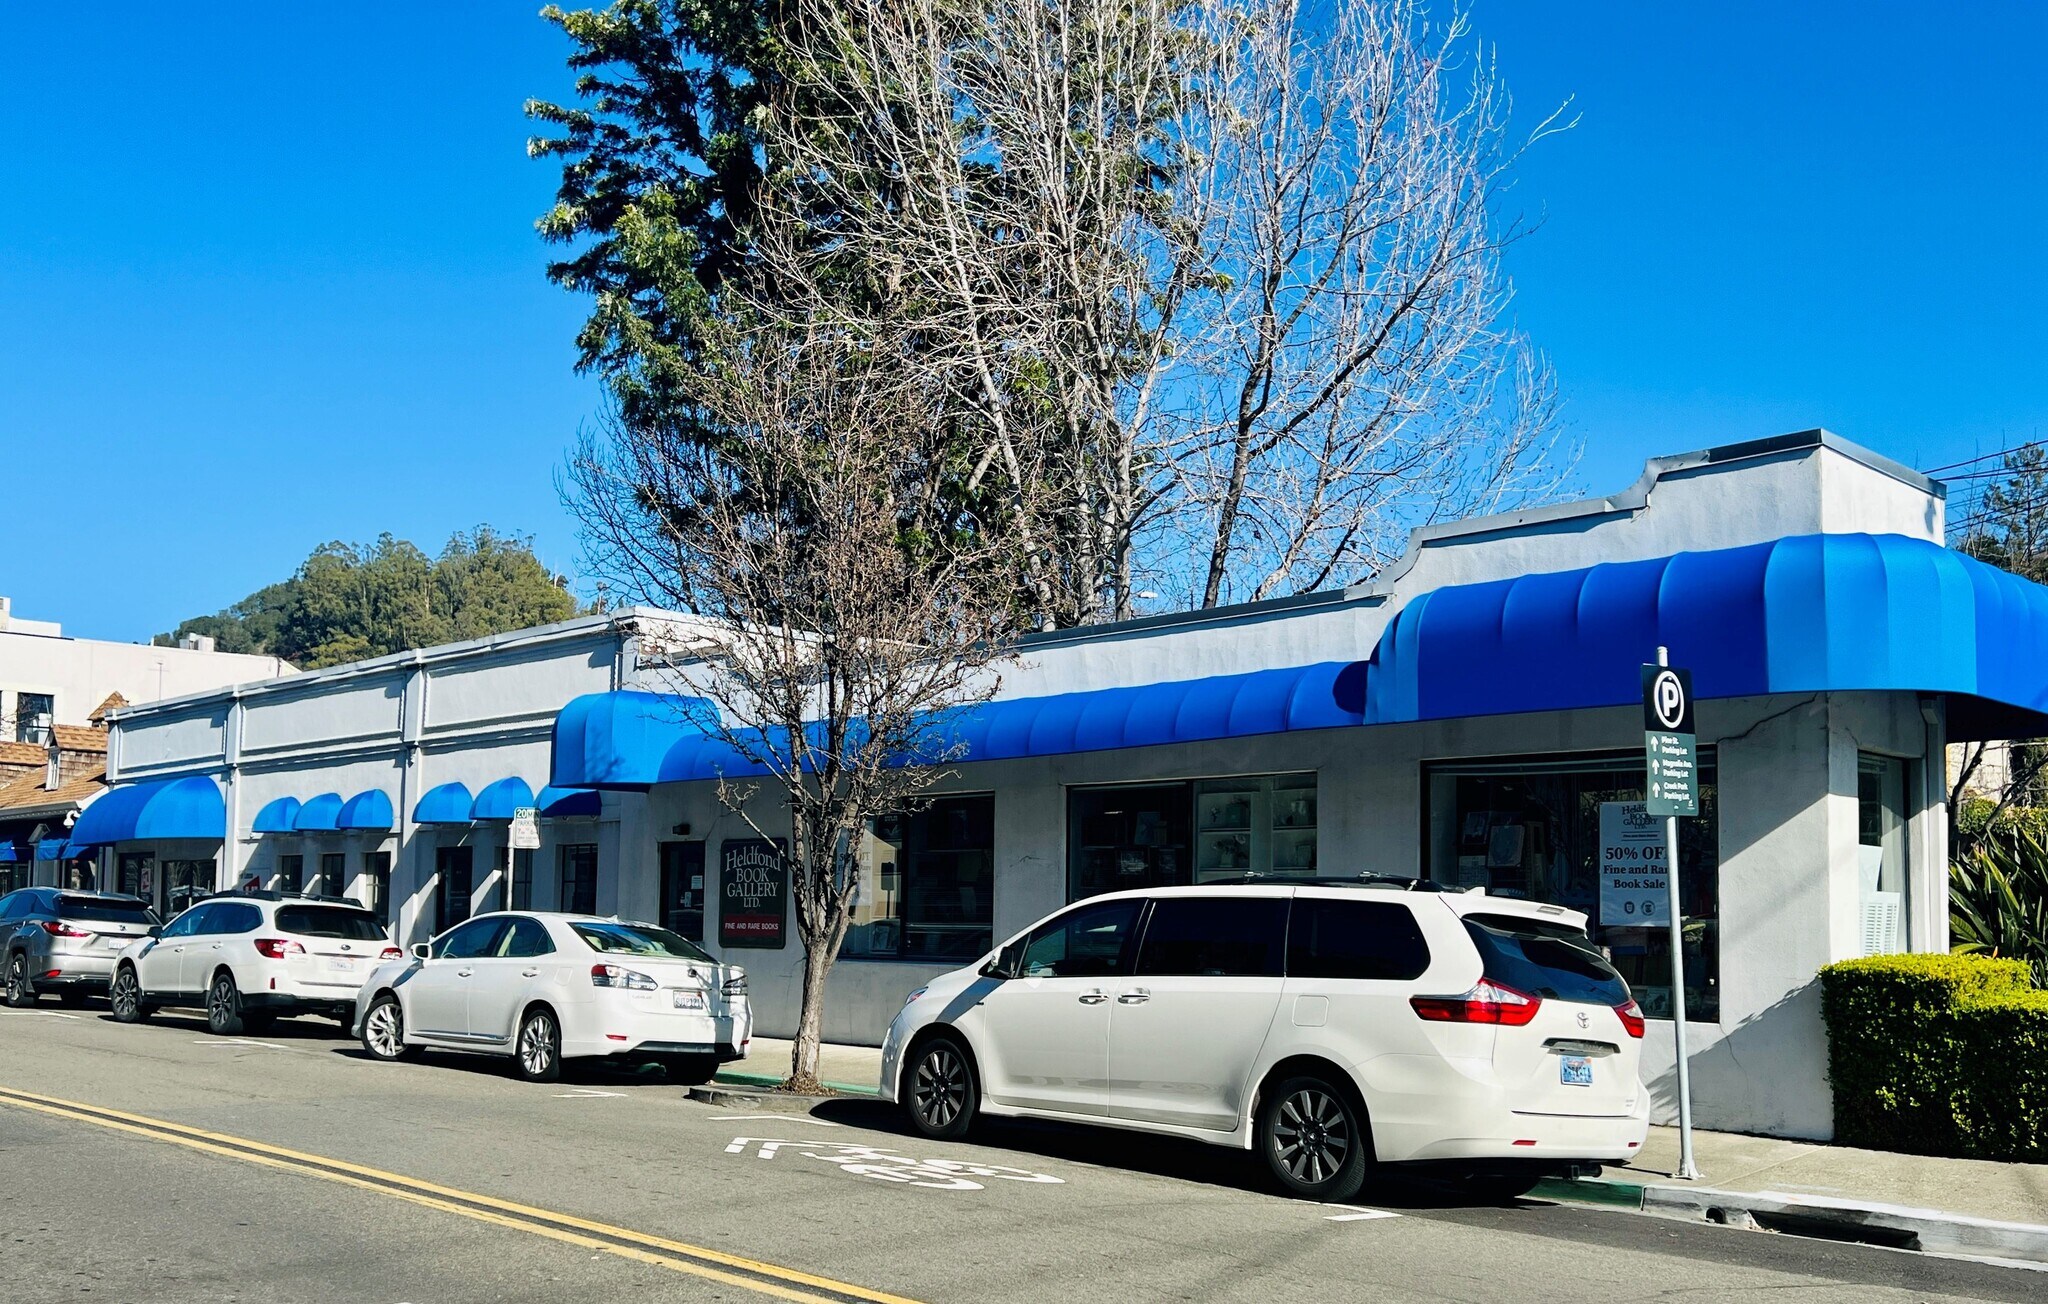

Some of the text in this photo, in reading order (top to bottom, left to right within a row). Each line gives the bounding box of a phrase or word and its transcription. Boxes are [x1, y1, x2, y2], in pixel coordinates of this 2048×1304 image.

[1661, 681, 1679, 717] P
[1662, 746, 1679, 756] Parking
[1663, 770, 1680, 779] Parking
[1664, 792, 1682, 802] Parking
[517, 809, 527, 818] 20
[1606, 846, 1667, 860] 50% OF
[726, 846, 781, 872] Heldfond
[1604, 865, 1626, 874] Fine
[1628, 865, 1648, 874] and
[736, 868, 769, 882] BOOK
[1614, 879, 1665, 888] Book Sale
[727, 882, 778, 897] GALLERY
[744, 897, 760, 908] LTD.
